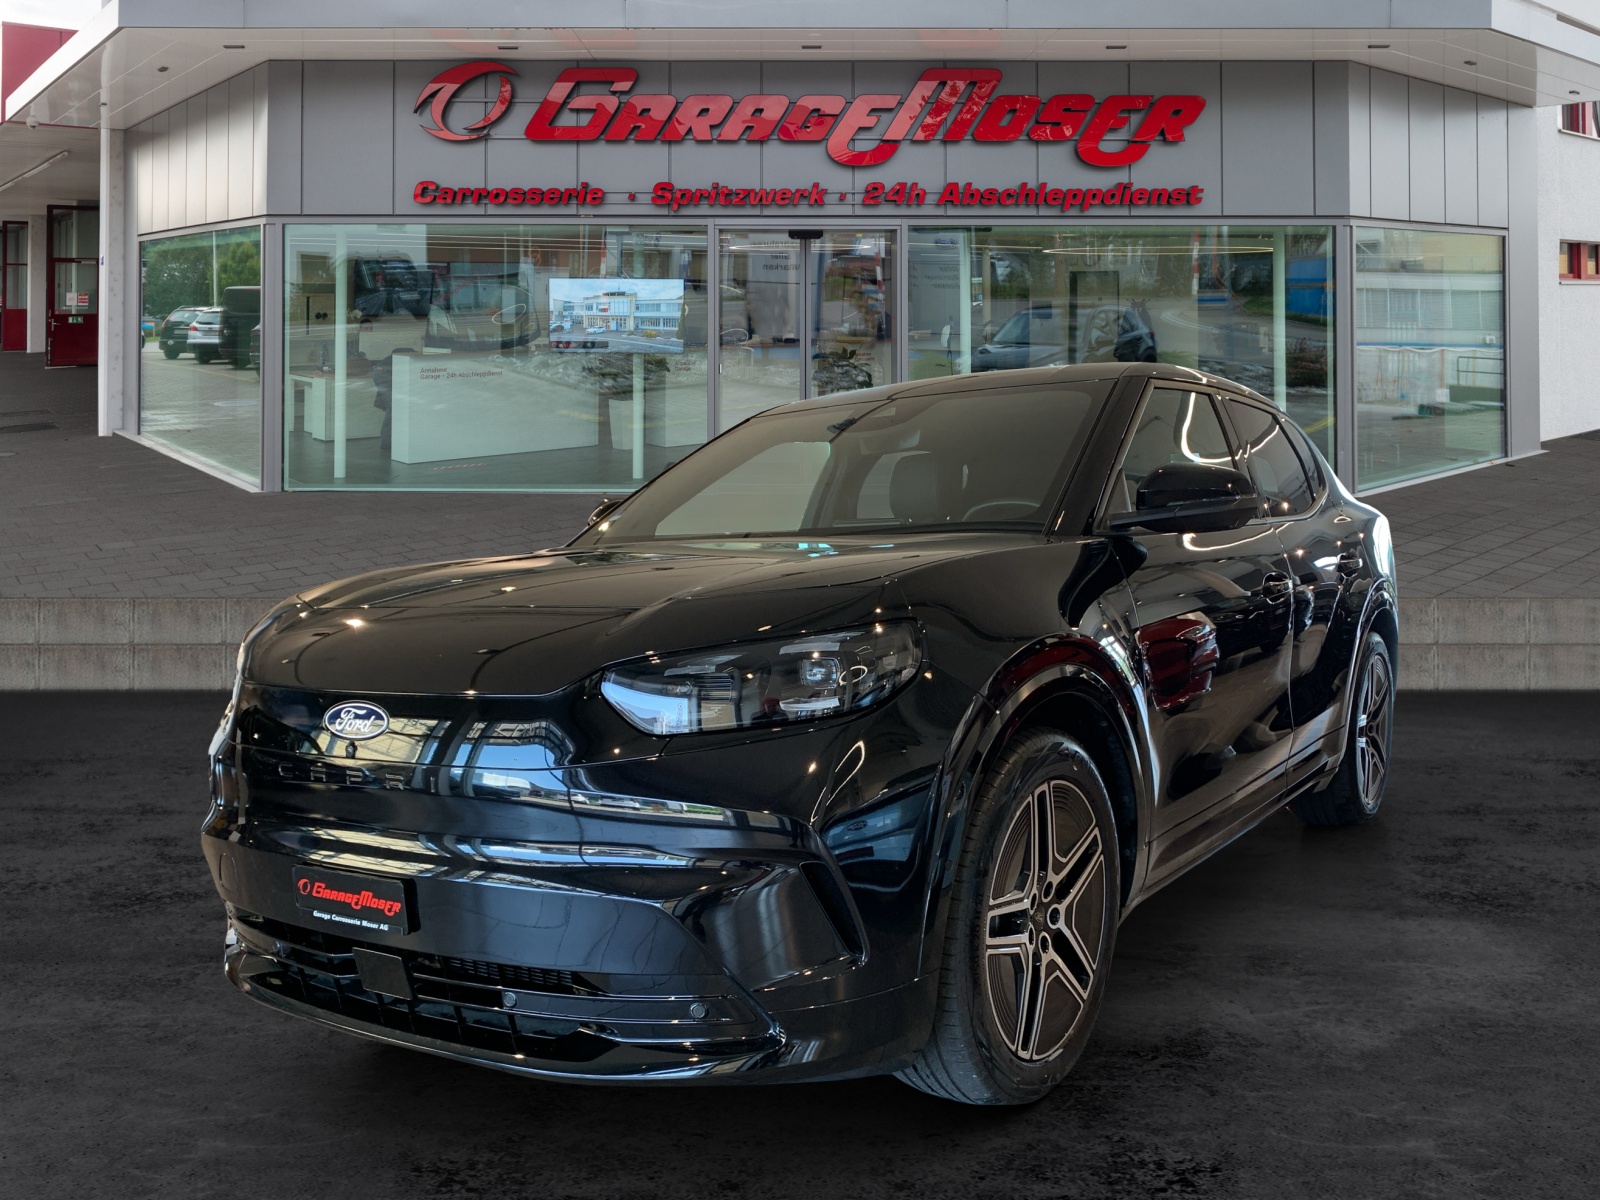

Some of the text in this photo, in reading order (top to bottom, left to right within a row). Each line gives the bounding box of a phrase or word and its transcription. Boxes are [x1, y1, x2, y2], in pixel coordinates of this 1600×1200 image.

[413, 181, 1204, 212] Carrosserie Spritzwerk 24h Abschleppdienst
[458, 370, 503, 378] Abschleppdienst
[335, 707, 376, 733] Ford
[278, 762, 436, 793] CAPRI
[313, 910, 331, 920] Garage
[331, 914, 361, 926] Carrosserie
[361, 919, 379, 929] Moser
